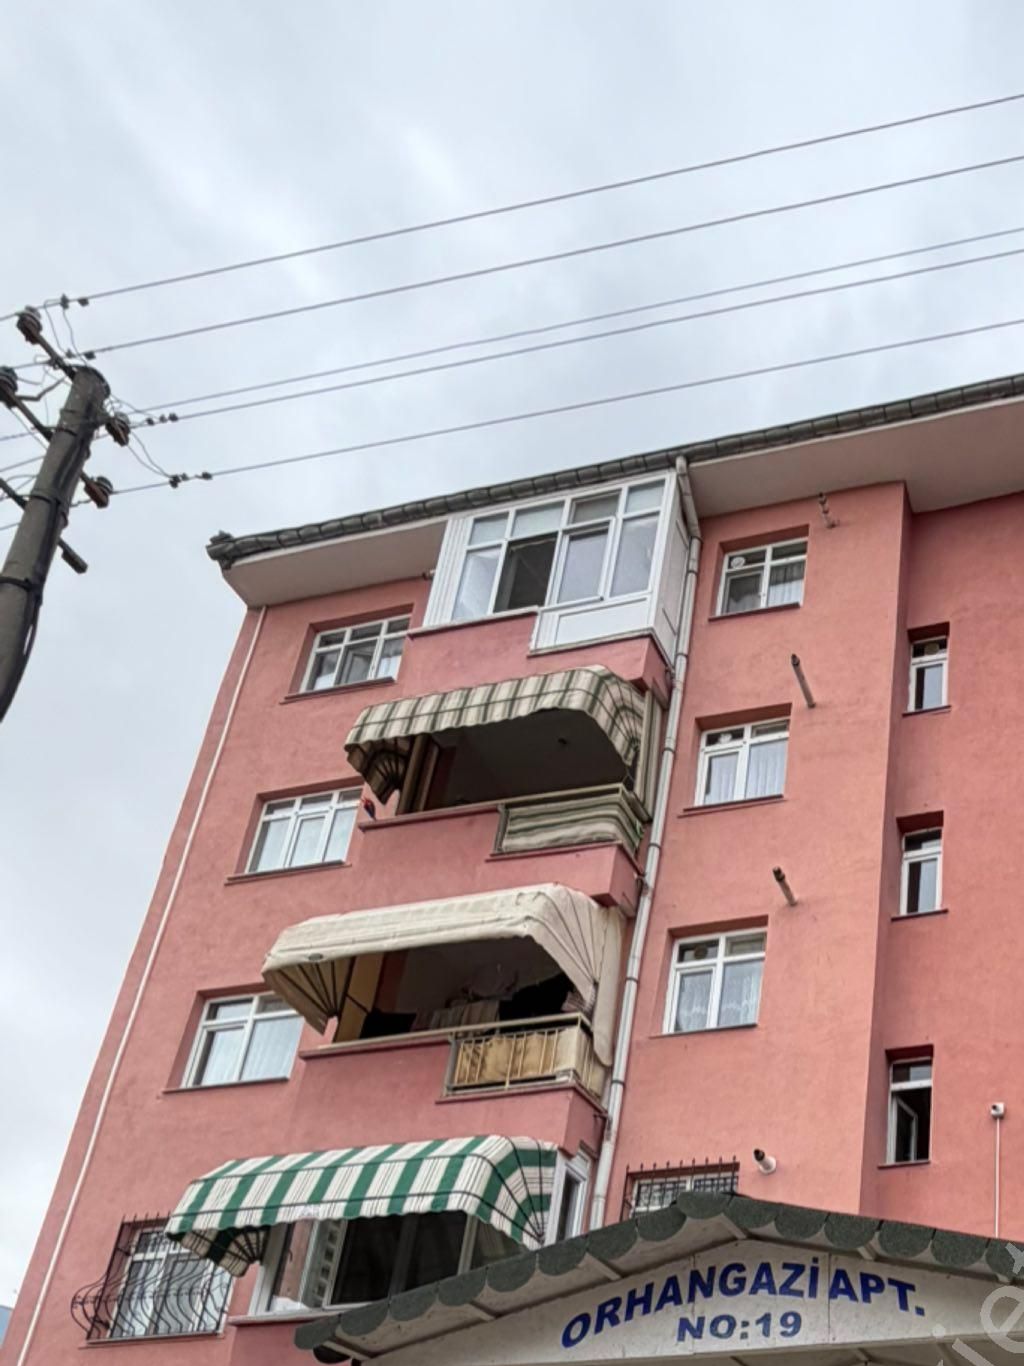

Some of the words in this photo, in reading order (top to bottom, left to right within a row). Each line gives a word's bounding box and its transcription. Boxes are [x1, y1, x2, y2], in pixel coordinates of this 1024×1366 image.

[561, 1256, 819, 1348] ORHANGAZİ
[828, 1268, 926, 1317] APT.
[676, 1310, 802, 1342] NO:19
